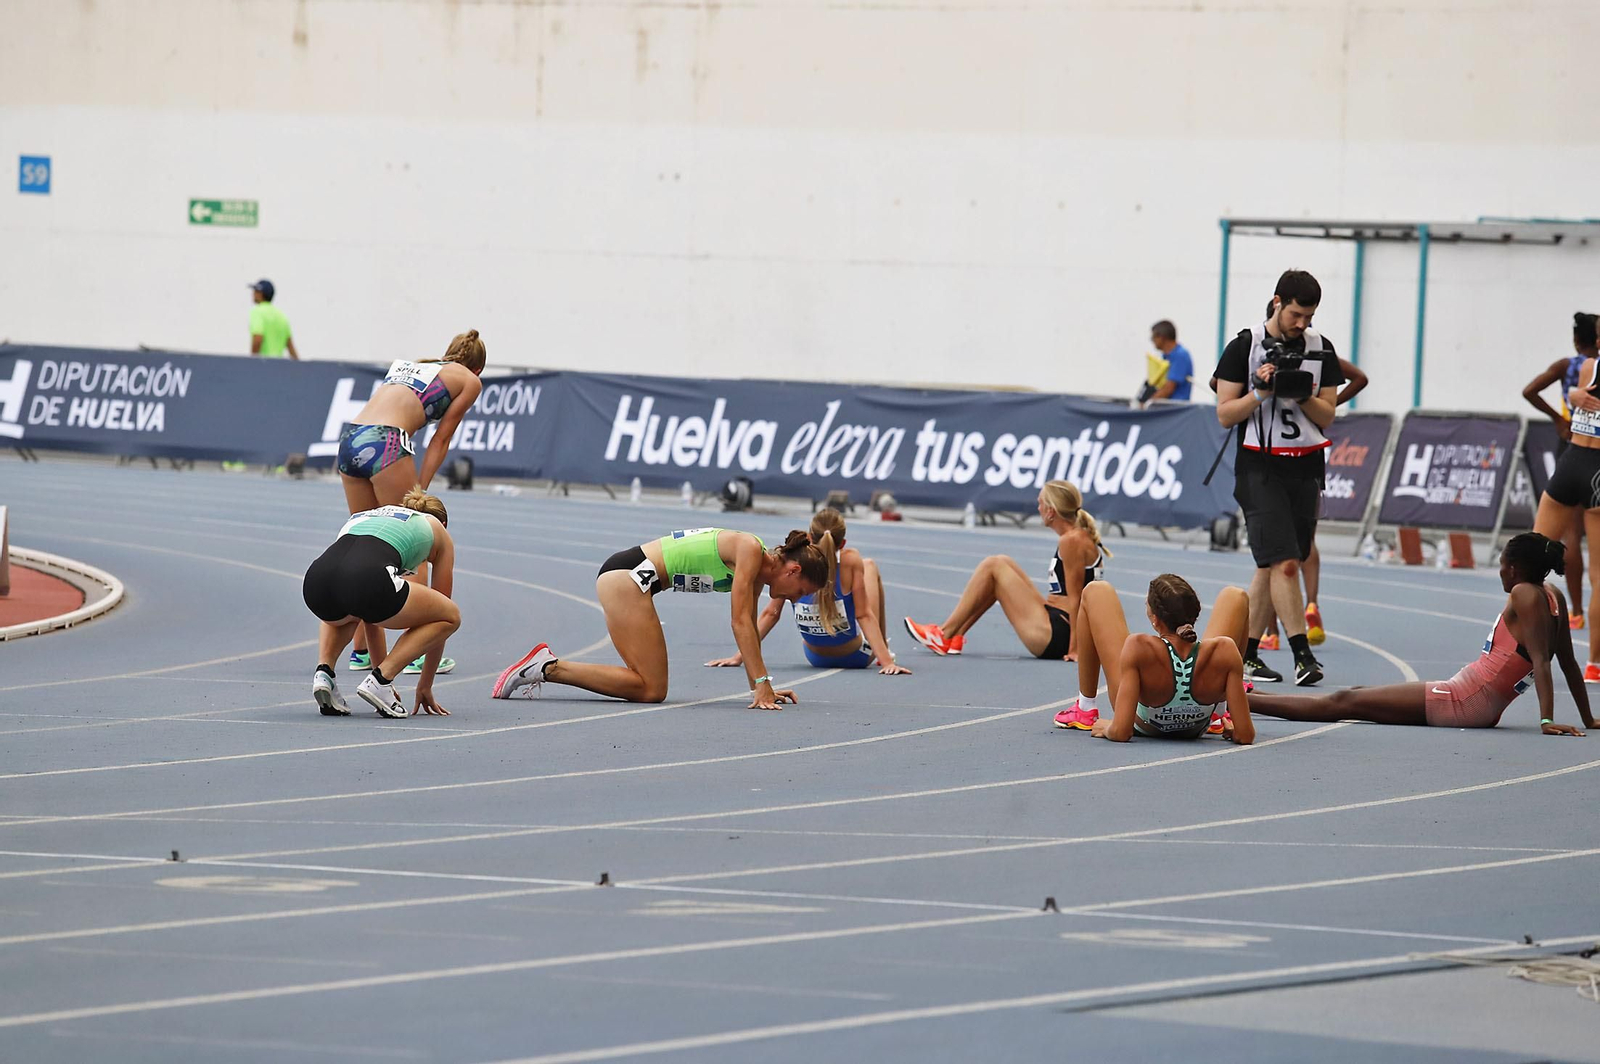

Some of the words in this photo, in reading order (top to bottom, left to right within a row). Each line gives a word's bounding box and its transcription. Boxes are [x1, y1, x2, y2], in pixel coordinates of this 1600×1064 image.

[37, 360, 192, 398] DIPUTACIÓN
[28, 395, 65, 426] DE
[67, 397, 166, 432] HUELVA
[466, 380, 541, 416] ACIÓN
[1281, 409, 1300, 440] 5
[604, 395, 778, 471] Huelva
[780, 399, 906, 481] eleva
[911, 418, 985, 484] tus
[984, 420, 1183, 500] sentidos.
[636, 569, 655, 586] 4
[1154, 712, 1205, 721] HERING
